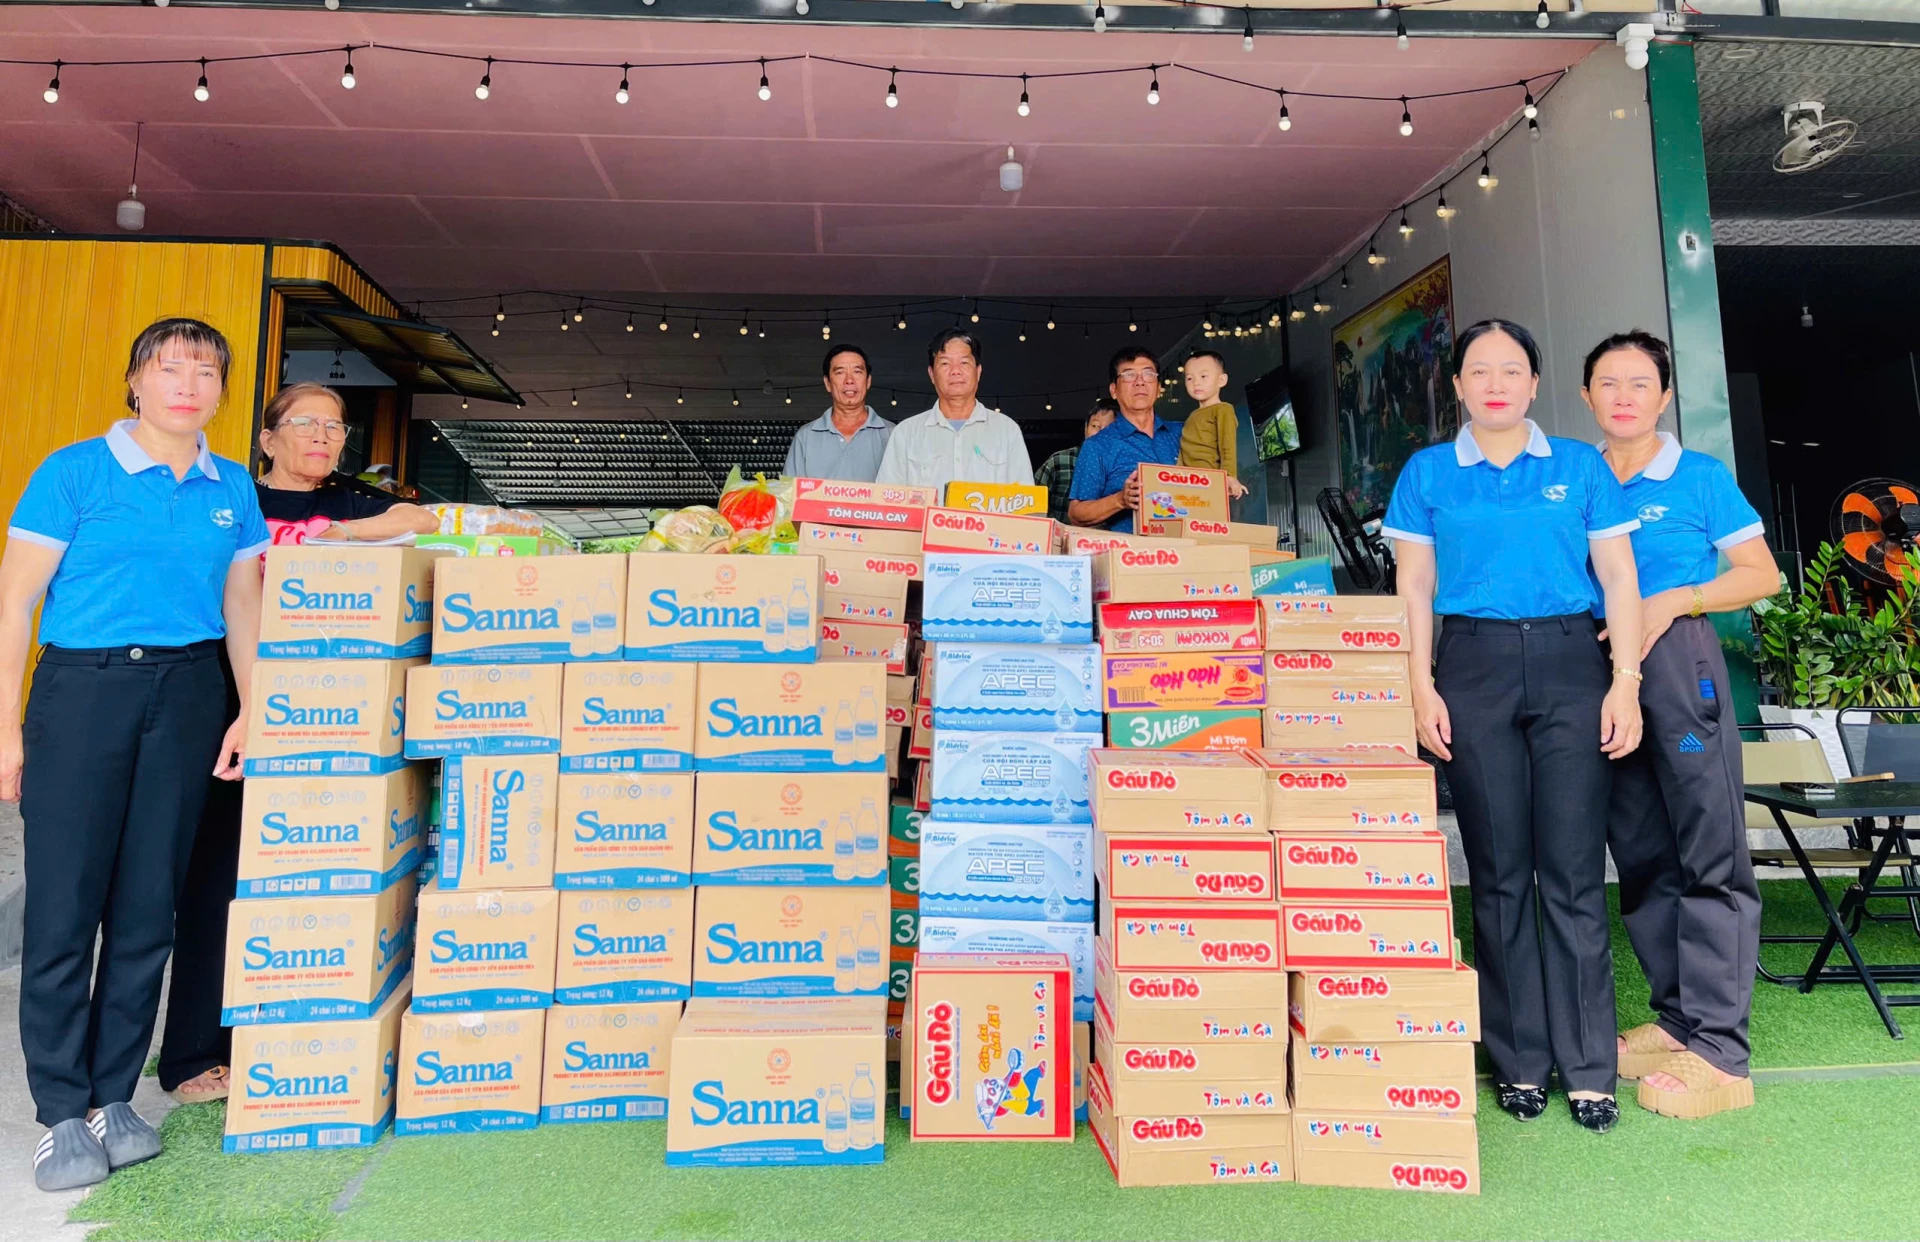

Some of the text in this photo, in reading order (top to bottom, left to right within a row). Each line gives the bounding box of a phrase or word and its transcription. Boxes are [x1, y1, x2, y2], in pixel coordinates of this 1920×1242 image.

[824, 485, 873, 499] KOKOMI
[965, 492, 983, 512] 3
[827, 507, 908, 523] TÔM CHUA CAY
[932, 513, 964, 530] Gấu
[1121, 550, 1156, 567] Gấu
[1183, 583, 1238, 594] Tôm và Gà
[1252, 568, 1280, 591] iền
[279, 578, 373, 610] Sanna
[972, 587, 1041, 602] APEC
[442, 593, 560, 633] Sanna
[647, 589, 761, 628] Sanna
[1128, 608, 1218, 621] TÔM CHUA CAY
[1275, 601, 1334, 614] Tôm và Gà
[1177, 631, 1230, 645] KOKOMI
[1365, 631, 1401, 648] Gấu
[1273, 652, 1309, 669] Gấu
[981, 674, 1056, 689] APEC
[1150, 666, 1222, 694] Hảo Hảo
[436, 690, 527, 721] Sanna
[1332, 690, 1355, 702] Chay
[1357, 690, 1376, 701] Rau
[265, 693, 359, 726] Sanna
[583, 697, 665, 725] Sanna
[707, 698, 823, 738] Sanna
[1129, 716, 1150, 747] 3
[981, 765, 1051, 780] APEC
[1107, 769, 1149, 789] Gấu
[1278, 771, 1320, 789] Gấu
[489, 770, 525, 863] Sanna
[904, 812, 923, 840] 3
[1184, 812, 1252, 825] Tôm và Gà
[261, 812, 359, 845] Sanna
[575, 811, 667, 843] Sanna
[707, 811, 823, 852] Sanna
[932, 834, 957, 842] Bidrico
[1122, 854, 1189, 868] Tôm và Gà
[1288, 845, 1330, 865] Gấu
[966, 858, 1045, 875] APEC
[903, 862, 920, 892] 3
[1013, 875, 1044, 884] 2017
[1223, 874, 1265, 894] Gấu
[1365, 871, 1435, 885] Tôm và Gà
[895, 914, 915, 943] 3
[1292, 913, 1334, 932] Gấu
[573, 923, 666, 957] Sanna
[932, 929, 957, 937] Bidrico
[243, 936, 345, 971] Sanna
[431, 929, 528, 964] Sanna
[706, 923, 825, 965] Sanna
[1369, 939, 1439, 953] Tôm và Gà
[890, 968, 910, 998] 3
[1128, 977, 1171, 998] Gấu
[1317, 977, 1360, 997] Gấu
[1033, 982, 1046, 1051] Tôm và Gà
[1203, 1022, 1272, 1036] Tôm và Gà
[564, 1041, 649, 1072] Sanna
[415, 1051, 513, 1086] Sanna
[926, 1044, 952, 1104] Gấu
[247, 1063, 349, 1098] Sanna
[691, 1080, 820, 1127] Sanna
[1132, 1119, 1175, 1140] Gấu
